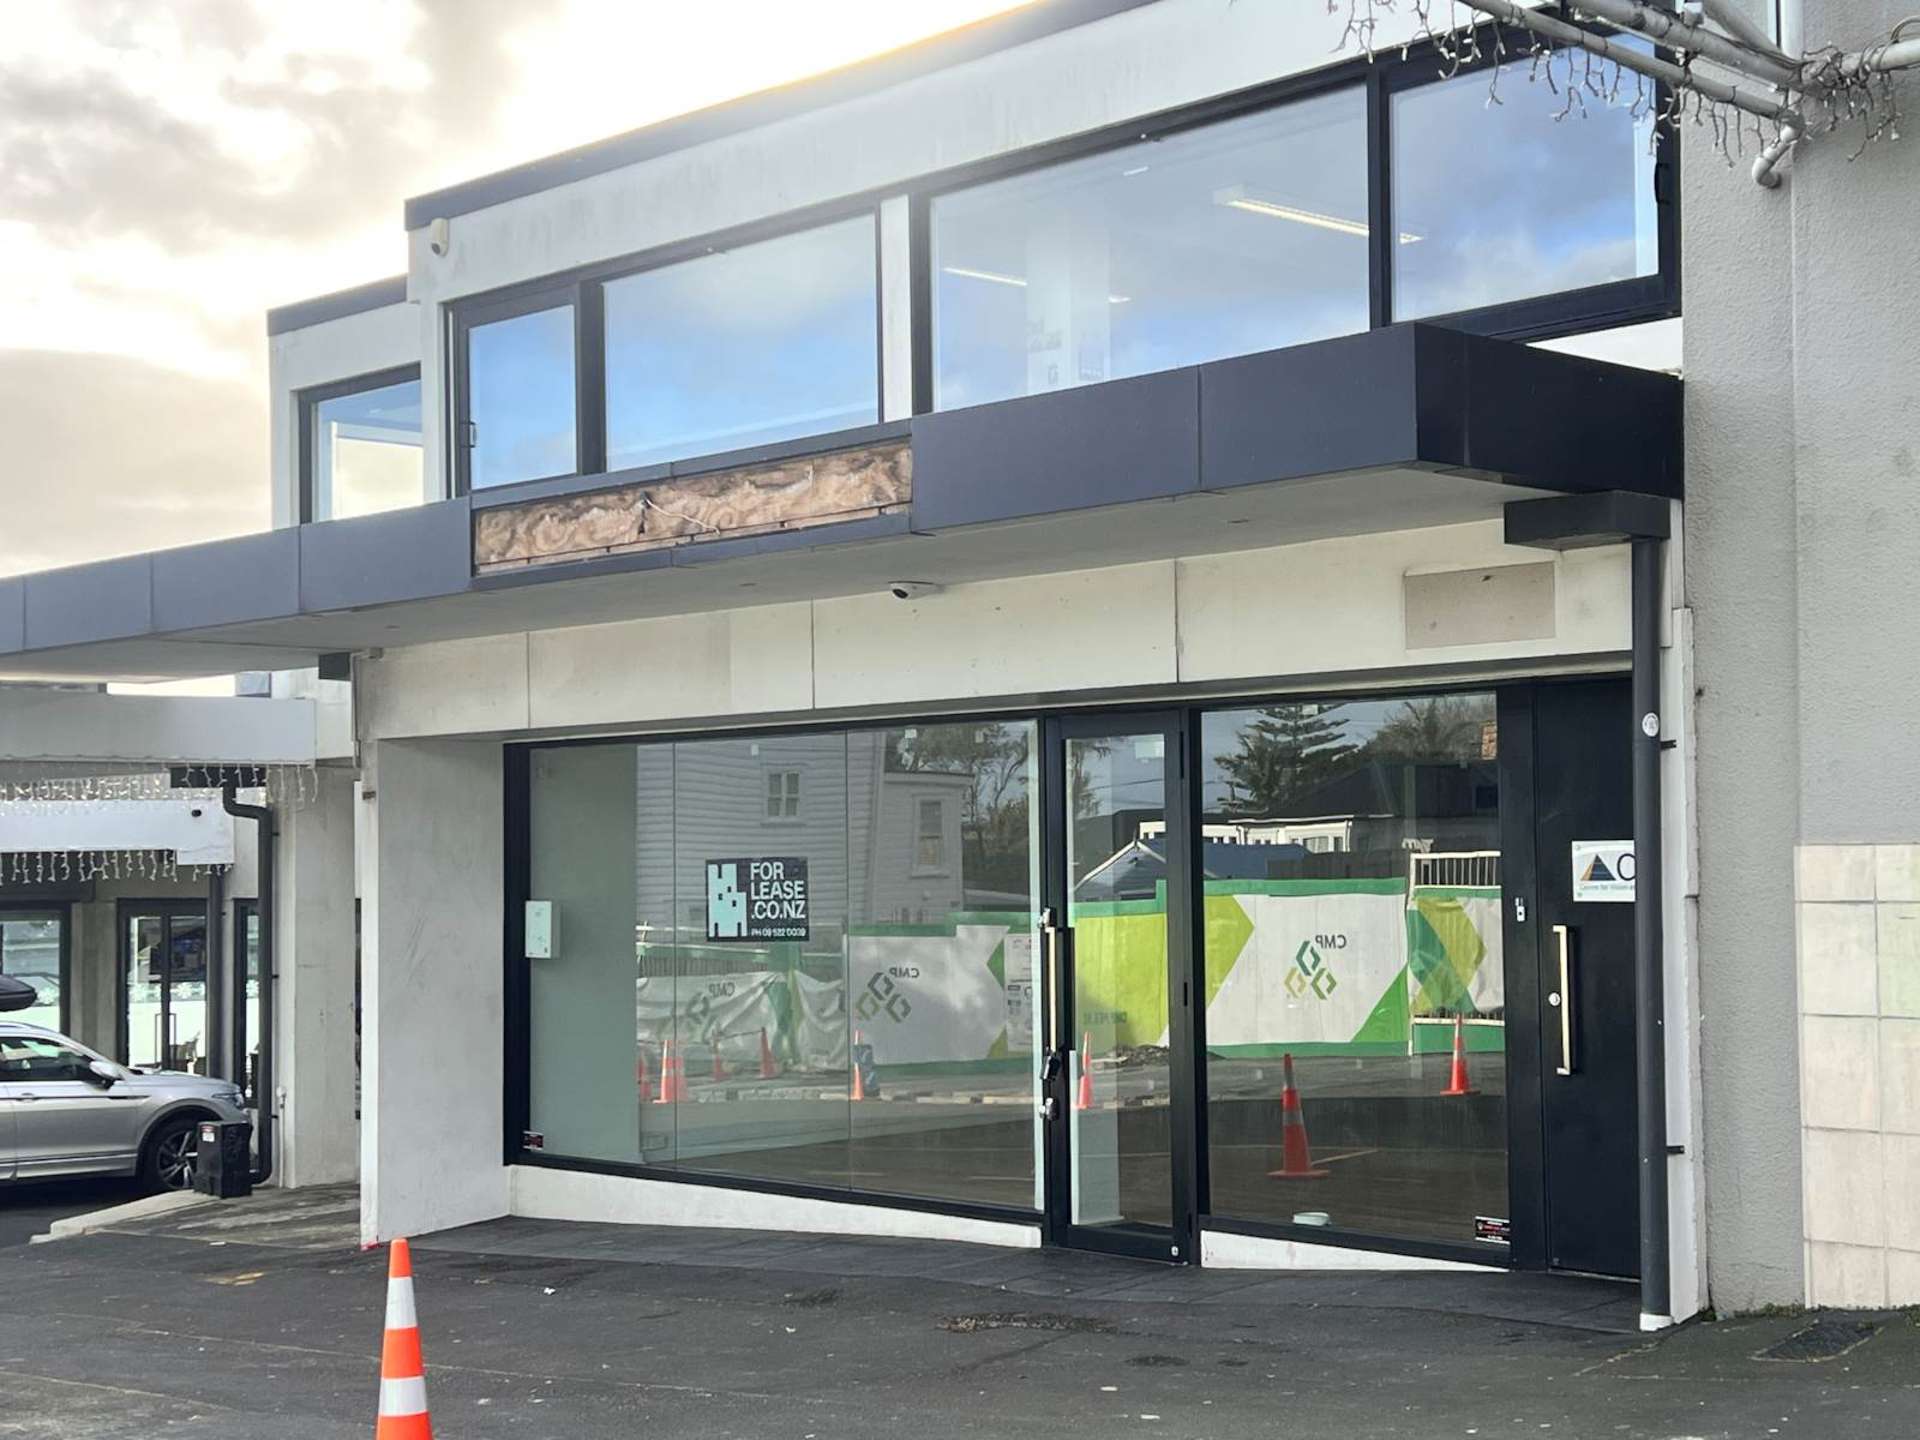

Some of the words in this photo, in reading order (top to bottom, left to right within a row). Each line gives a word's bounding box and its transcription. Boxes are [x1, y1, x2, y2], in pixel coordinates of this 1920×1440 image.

[750, 862, 784, 880] FOR
[751, 881, 805, 900] LEASE
[751, 901, 805, 919] .CO.NZ
